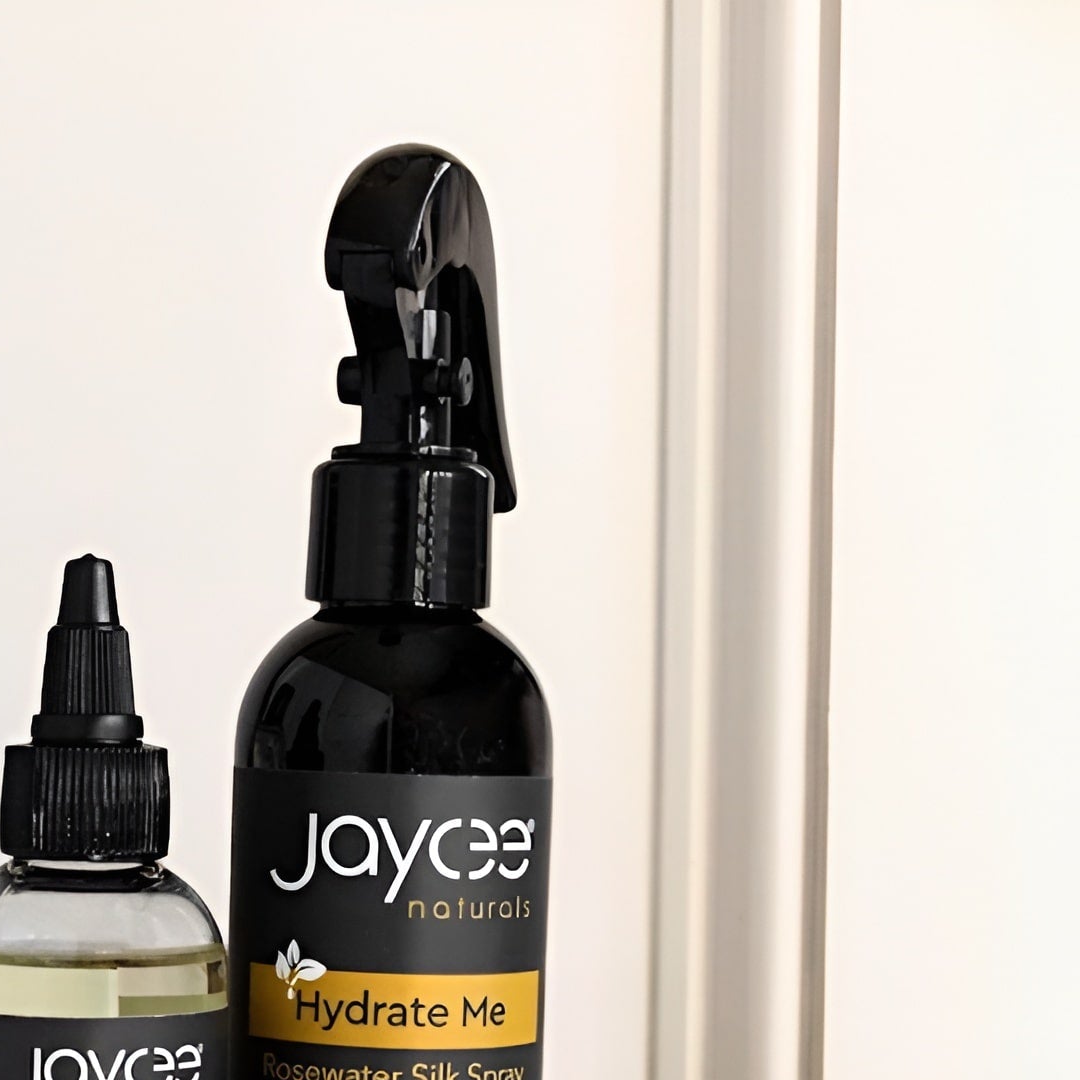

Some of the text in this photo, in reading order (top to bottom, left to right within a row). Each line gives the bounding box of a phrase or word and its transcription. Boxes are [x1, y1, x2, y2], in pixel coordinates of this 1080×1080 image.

[407, 895, 531, 920] naturals
[295, 990, 506, 1031] Hydrate Me
